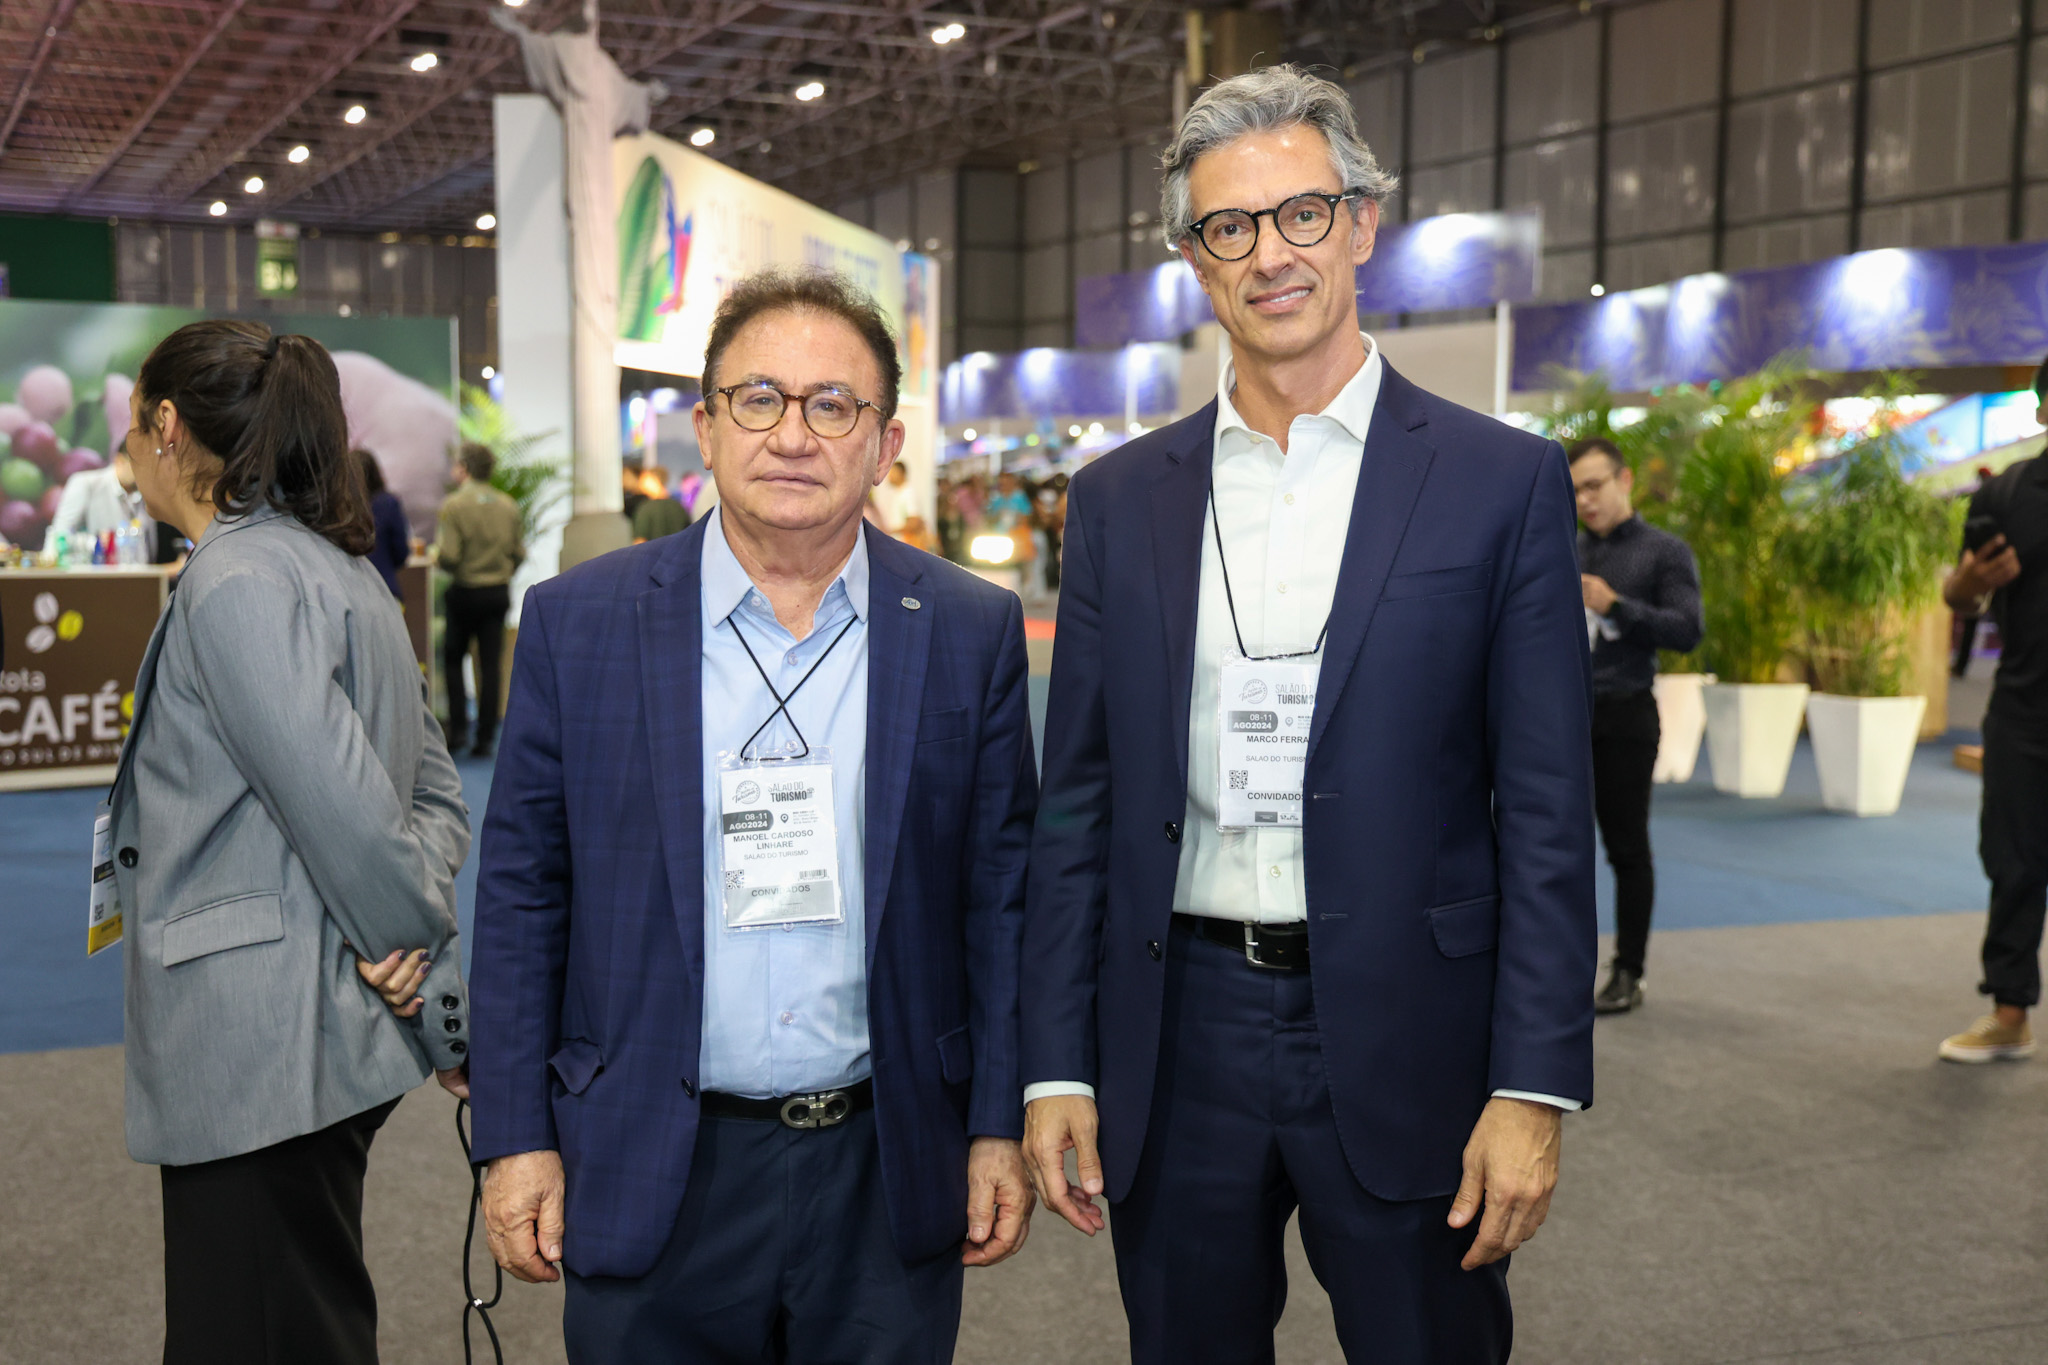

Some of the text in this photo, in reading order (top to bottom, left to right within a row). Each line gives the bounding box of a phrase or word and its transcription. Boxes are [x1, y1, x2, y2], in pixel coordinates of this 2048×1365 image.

[1233, 722, 1272, 730] AGO2024
[1246, 735, 1278, 743] MARCO
[771, 791, 807, 803] TURISMO
[1247, 792, 1303, 801] CONVIDADO
[745, 813, 768, 821] 08-11
[729, 820, 768, 831] AGO2024
[733, 829, 814, 843] MANOEL CARDOSO
[756, 840, 794, 850] LINHARE
[779, 850, 808, 858] TURISMO
